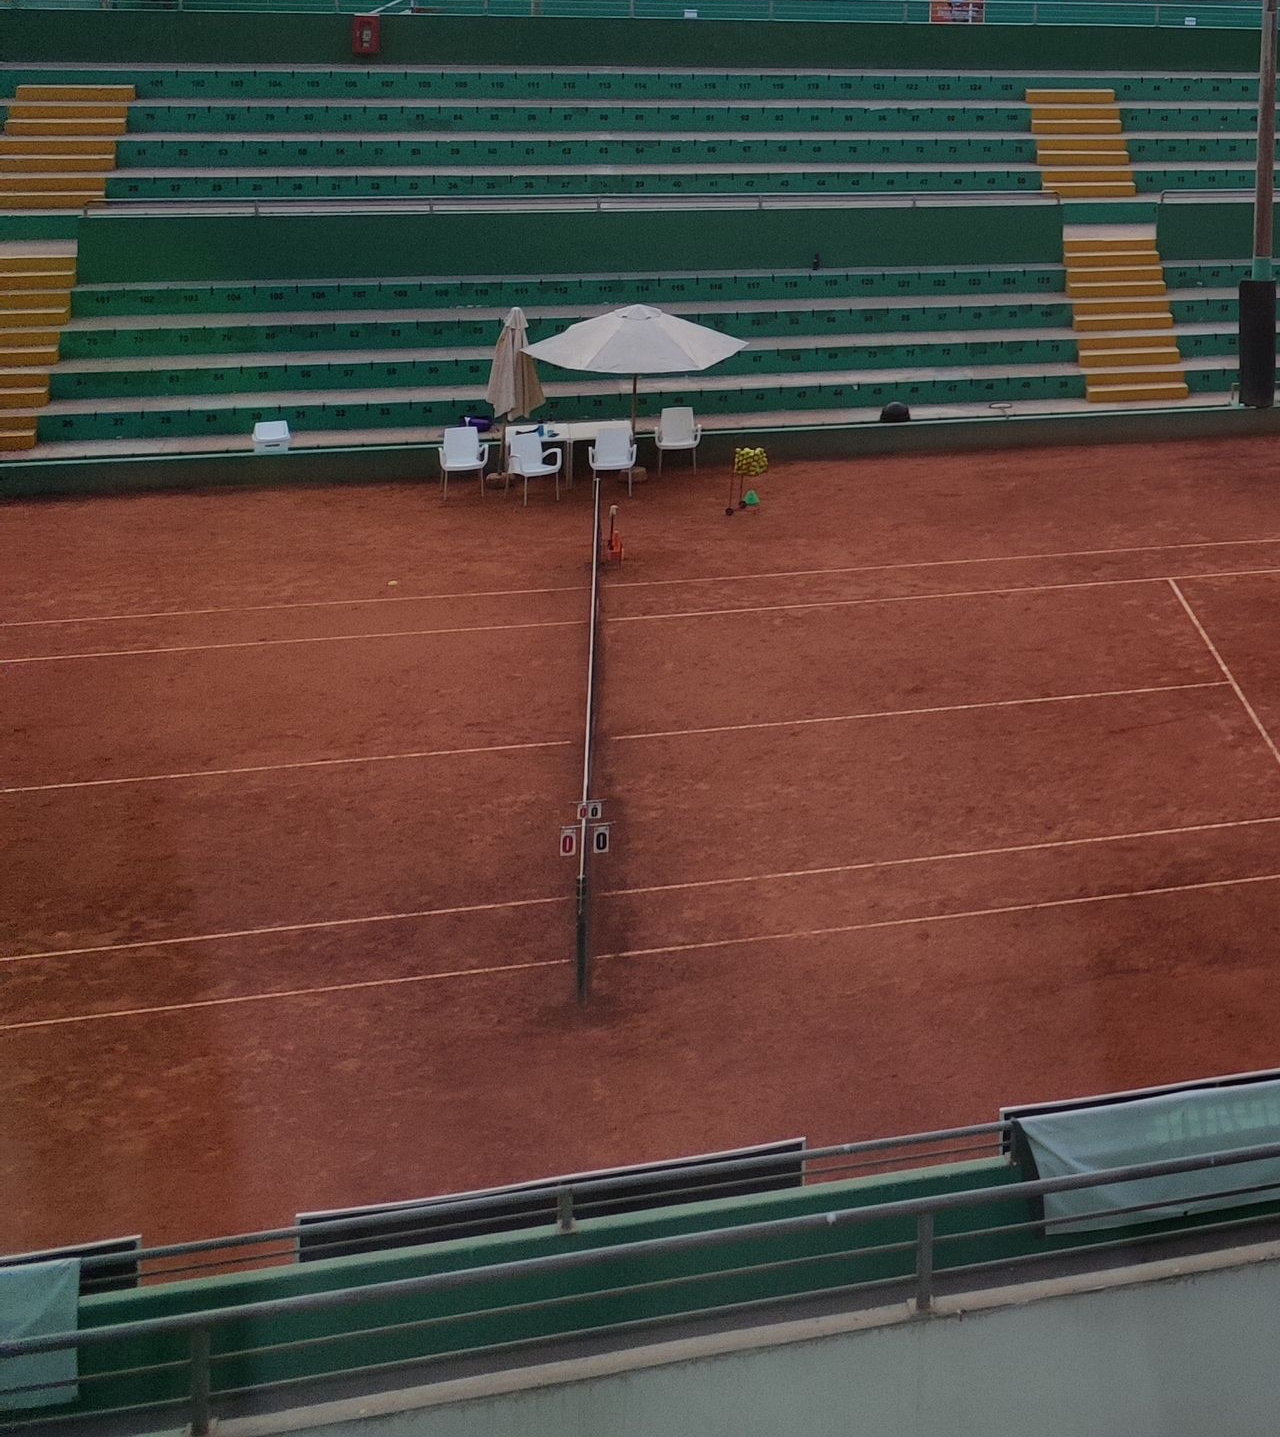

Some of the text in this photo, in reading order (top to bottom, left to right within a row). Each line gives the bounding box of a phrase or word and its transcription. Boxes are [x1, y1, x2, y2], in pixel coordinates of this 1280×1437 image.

[580, 807, 598, 818] 0 0
[562, 832, 607, 853] 0 0
